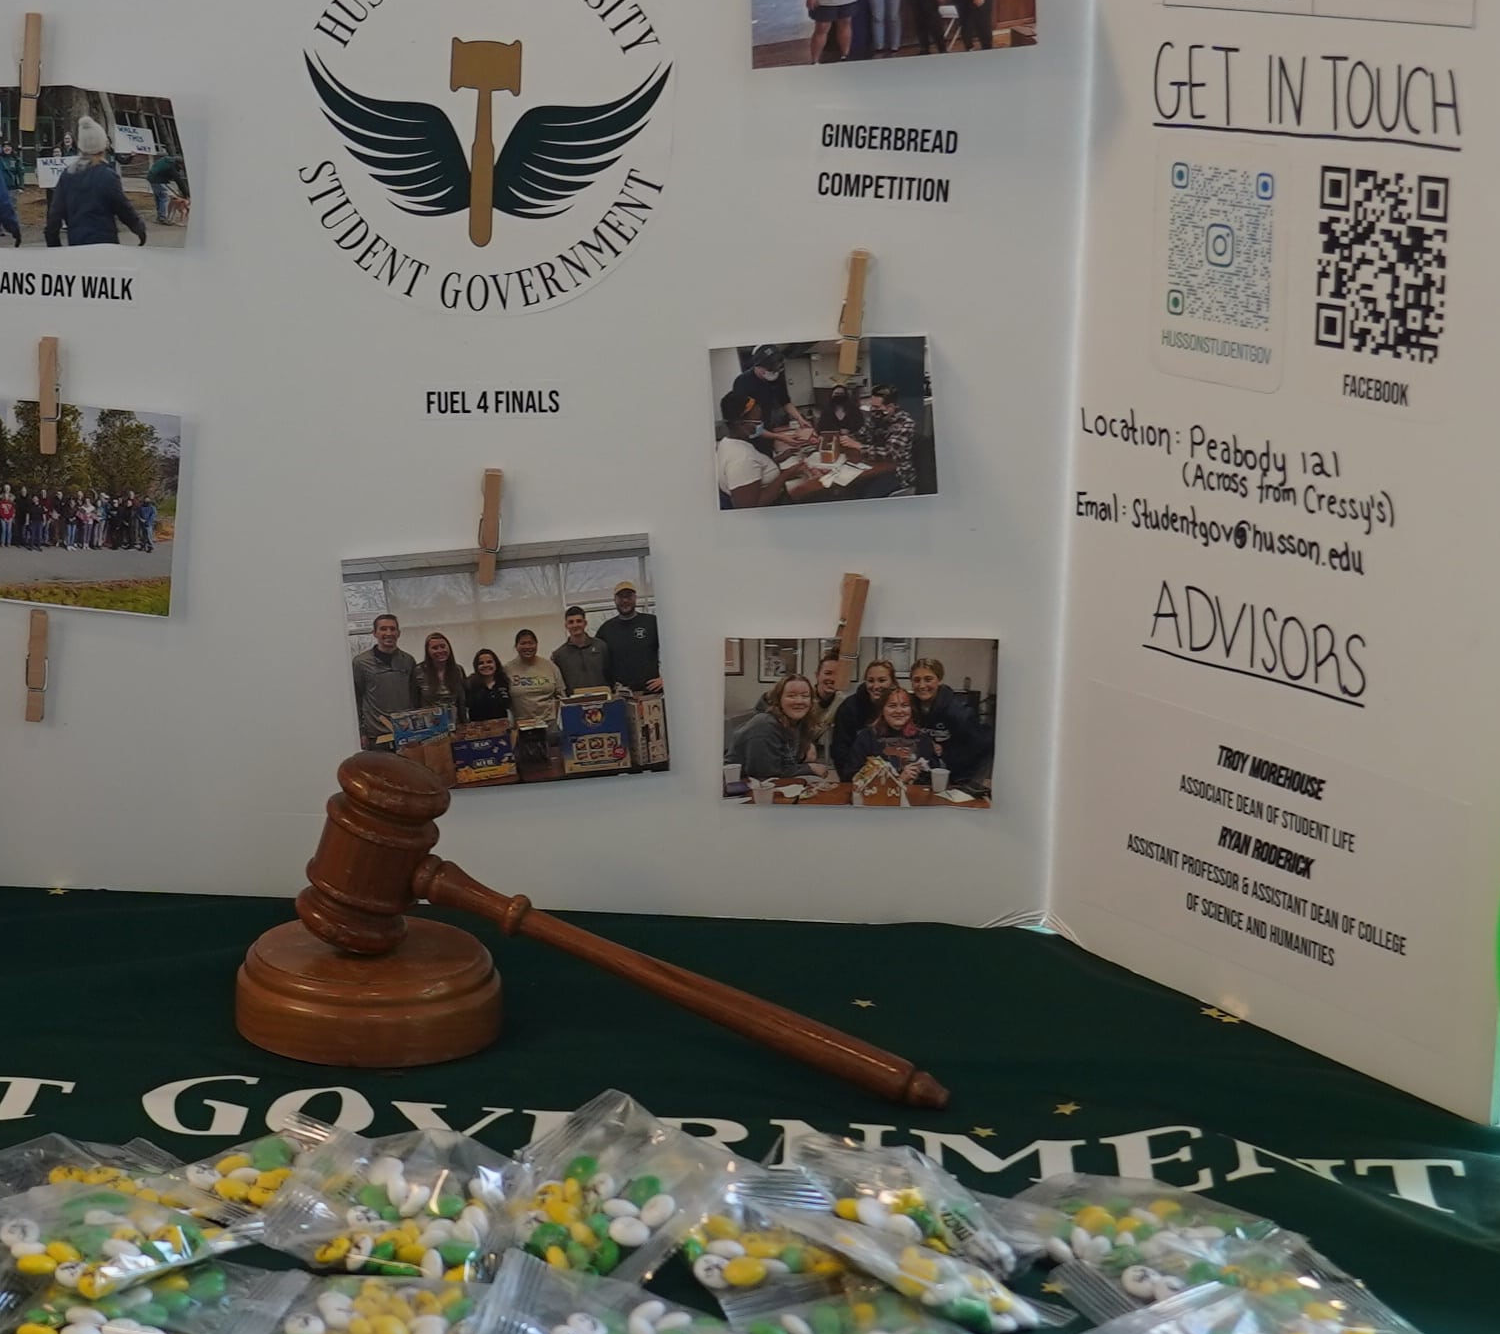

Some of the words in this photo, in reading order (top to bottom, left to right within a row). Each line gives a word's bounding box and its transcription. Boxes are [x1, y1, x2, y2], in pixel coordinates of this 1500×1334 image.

[1154, 42, 1240, 126] GET
[1268, 54, 1306, 126] IN
[1321, 55, 1461, 135] TOUCH
[821, 123, 958, 155] GINGERBREAD
[818, 172, 950, 203] COMPETITION
[299, 161, 429, 297] STUDENT
[441, 168, 664, 312] GOVERNMENT
[41, 273, 76, 299] DAY
[81, 275, 133, 301] WALK
[1161, 329, 1272, 365] HUSSONSTUDENTGOV
[426, 390, 471, 415] FUEL
[476, 390, 489, 414] 4
[495, 389, 559, 414] FINALS
[1342, 374, 1409, 407] FACEBOOK
[1081, 407, 1181, 455] Location:
[1189, 425, 1287, 485] Peabody
[1076, 491, 1127, 523] Email:
[1182, 461, 1248, 499] (Across
[1257, 478, 1296, 506] from
[1304, 485, 1395, 535] Cressy's)
[1151, 580, 1366, 698] ADVISORS
[1217, 745, 1249, 768] TROY
[1248, 756, 1326, 801] MOREHOUSE
[1179, 774, 1234, 810] ASSOCIATE
[1236, 795, 1262, 820] DEAN
[1266, 804, 1280, 825] OF
[1282, 810, 1330, 844] STUDENT
[1332, 828, 1355, 853] LIFE
[1218, 826, 1251, 857] RYAN
[1251, 837, 1316, 880] RODERICK
[1127, 833, 1179, 870] ASSISTANT
[1182, 853, 1238, 892] PROFESSOR
[1242, 877, 1249, 895] &
[1251, 881, 1308, 918] ASSISTANT
[1310, 903, 1339, 930] DEAN
[1341, 915, 1355, 935] OF
[1358, 921, 1407, 957] COLLEGE
[1186, 892, 1199, 912] OF
[1201, 898, 1244, 932] SCIENCE
[1246, 916, 1267, 940] AND
[1269, 925, 1335, 967] HUMANITIES
